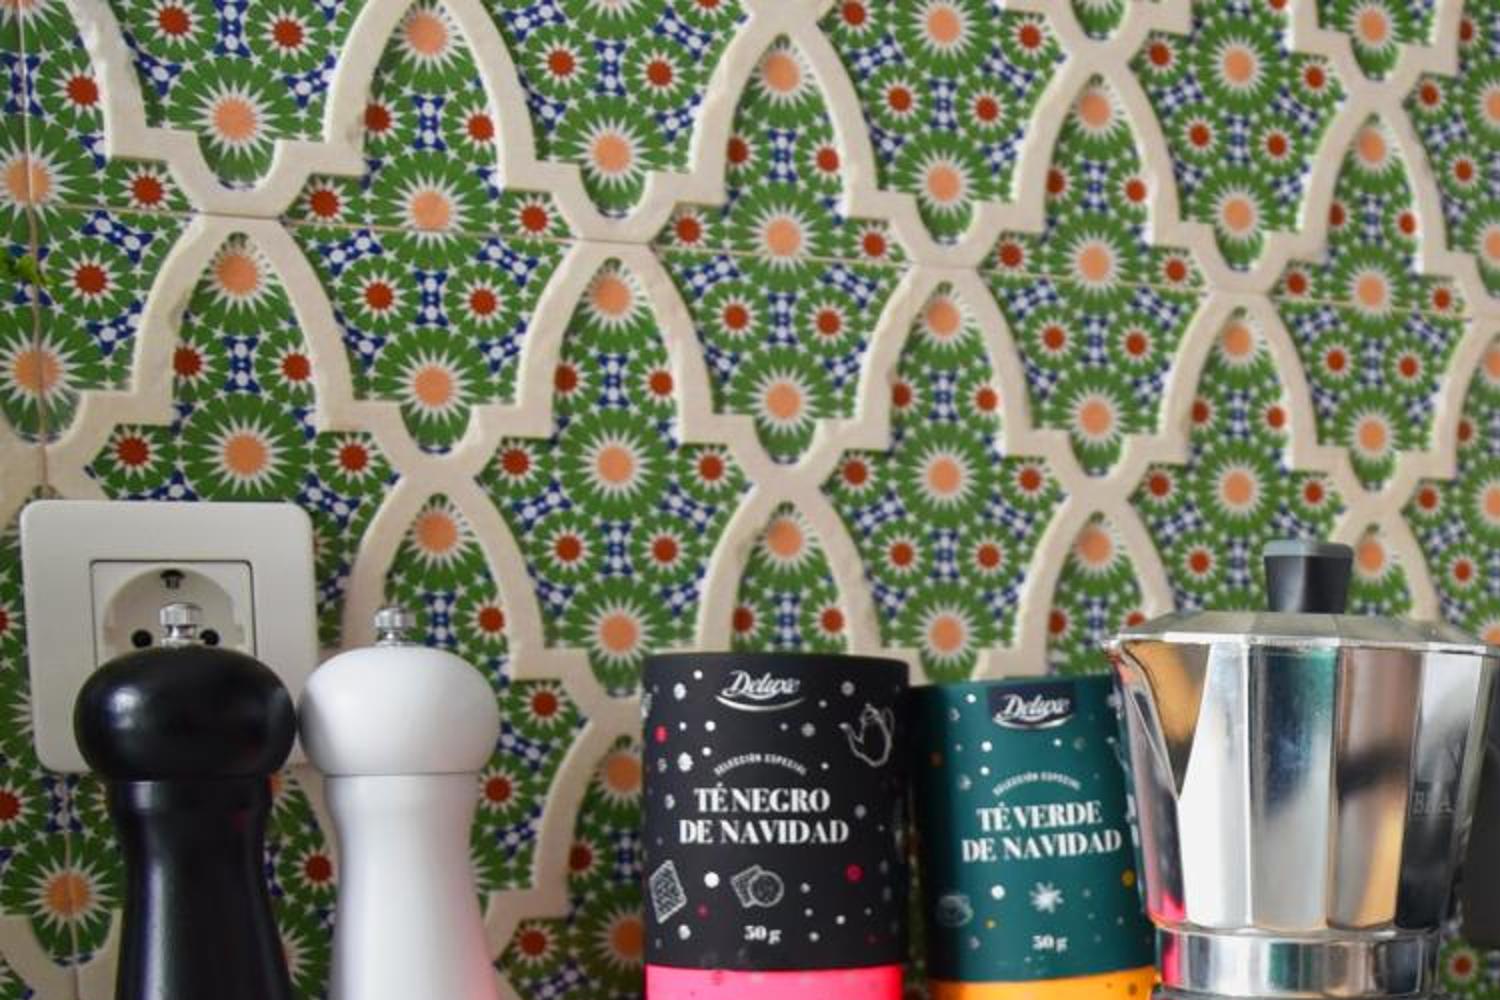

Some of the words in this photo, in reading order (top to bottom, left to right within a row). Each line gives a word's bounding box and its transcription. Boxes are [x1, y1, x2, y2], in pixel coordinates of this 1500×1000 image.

[721, 670, 801, 700] Deluxe
[995, 693, 1071, 721] Deluxe
[694, 782, 728, 813] TÉ
[731, 787, 831, 813] NEGRO
[976, 801, 1012, 832] TÉ
[1013, 800, 1103, 829] VERDE
[679, 819, 713, 844] DE
[720, 819, 849, 844] NAVIDAD
[961, 838, 997, 862] DE
[1002, 829, 1122, 861] NAVIDAD
[744, 925, 767, 941] 50
[768, 928, 782, 945] g
[1032, 934, 1055, 950] 50
